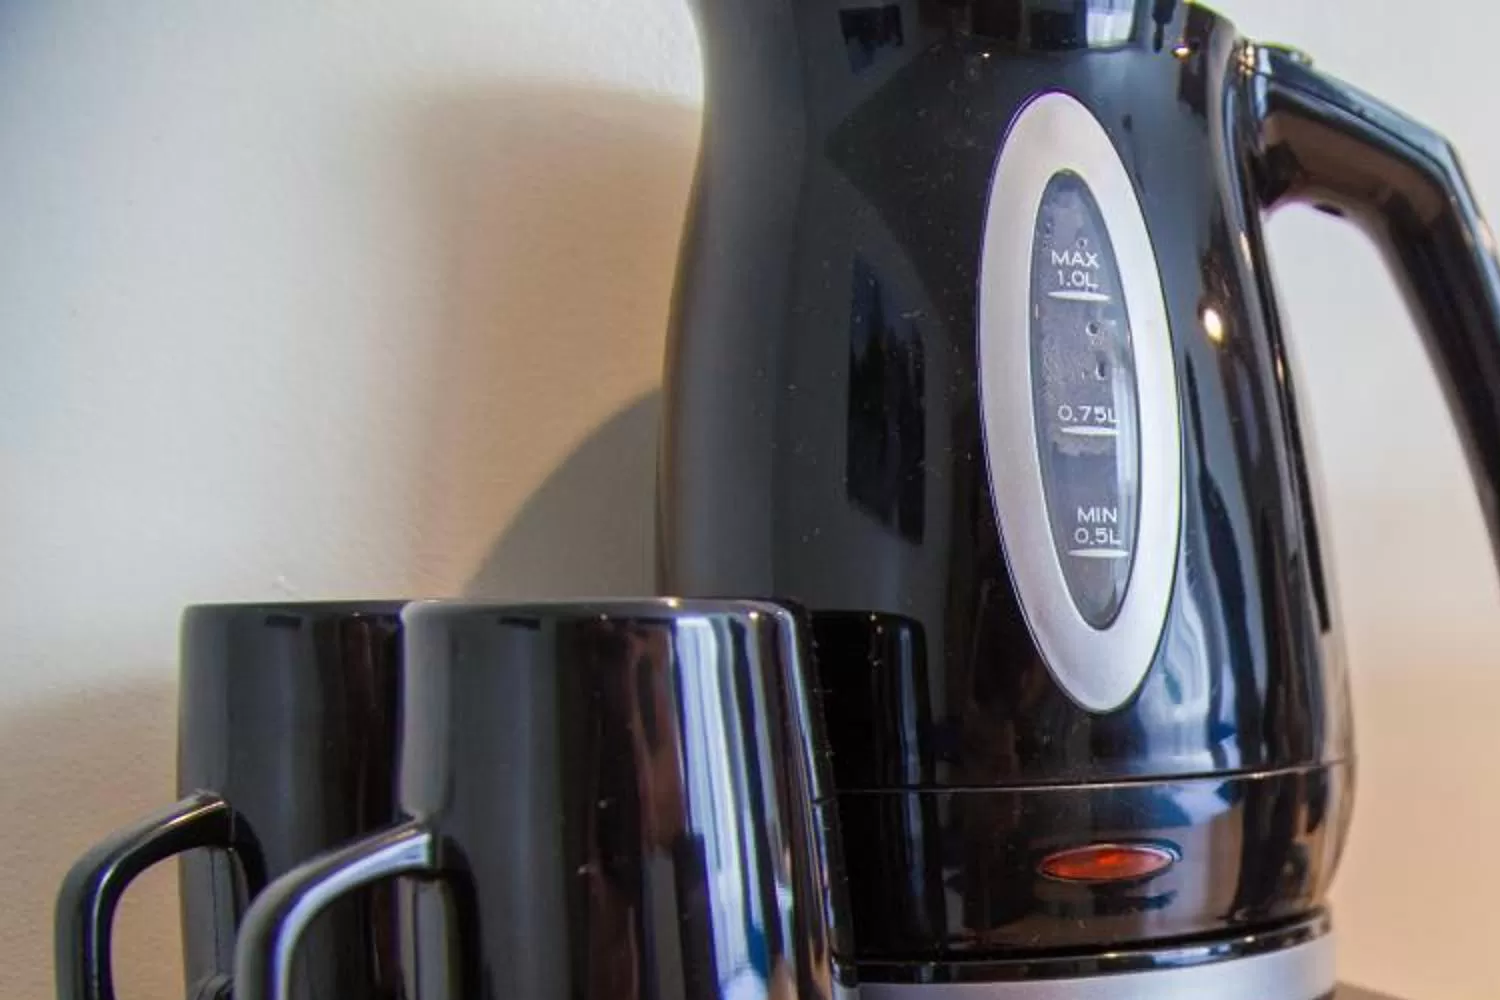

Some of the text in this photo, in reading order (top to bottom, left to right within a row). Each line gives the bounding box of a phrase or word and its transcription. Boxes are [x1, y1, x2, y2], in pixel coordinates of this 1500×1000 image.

[1051, 250, 1100, 269] MAX
[1057, 270, 1098, 288] 1.0L
[1057, 404, 1119, 423] 0.75L
[1077, 507, 1118, 524] MIN
[1074, 527, 1122, 545] 0.5L
